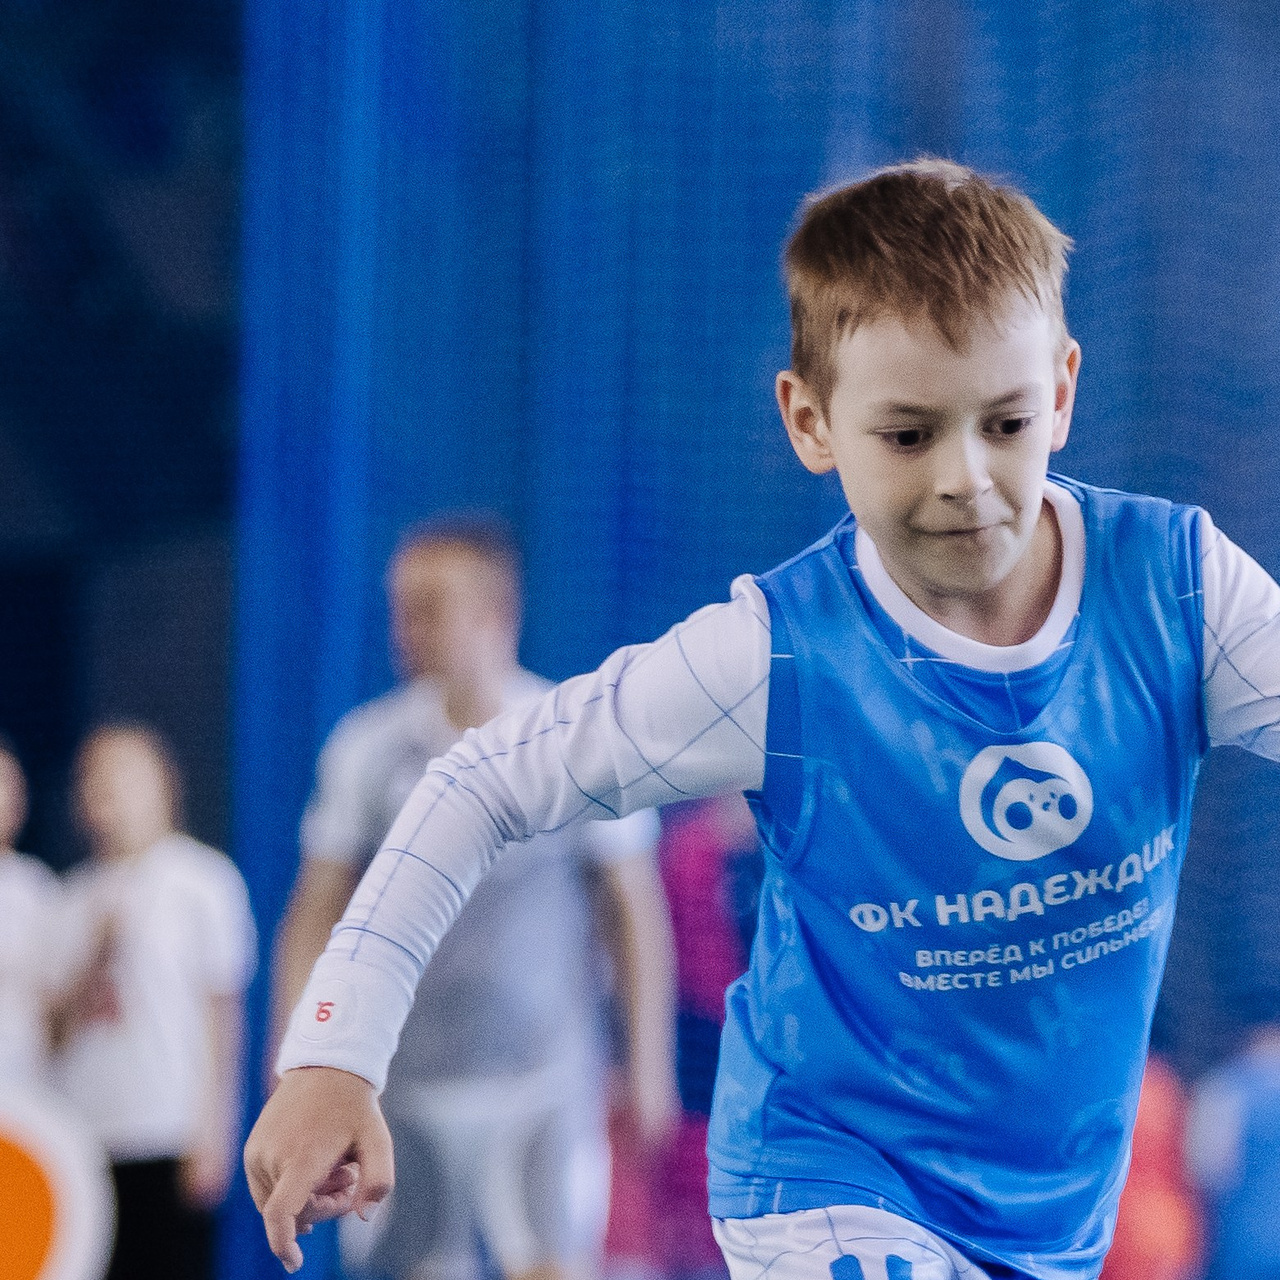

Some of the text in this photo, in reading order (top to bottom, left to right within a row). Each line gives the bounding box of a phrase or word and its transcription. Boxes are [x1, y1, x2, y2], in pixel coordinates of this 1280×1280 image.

[849, 822, 1177, 933] ФК НАДЕЖДИК
[915, 944, 1024, 968] ВПЕРЁД
[1028, 938, 1046, 956] К
[898, 970, 1002, 991] ВМЕСТЕ
[1010, 958, 1055, 984] МЫ
